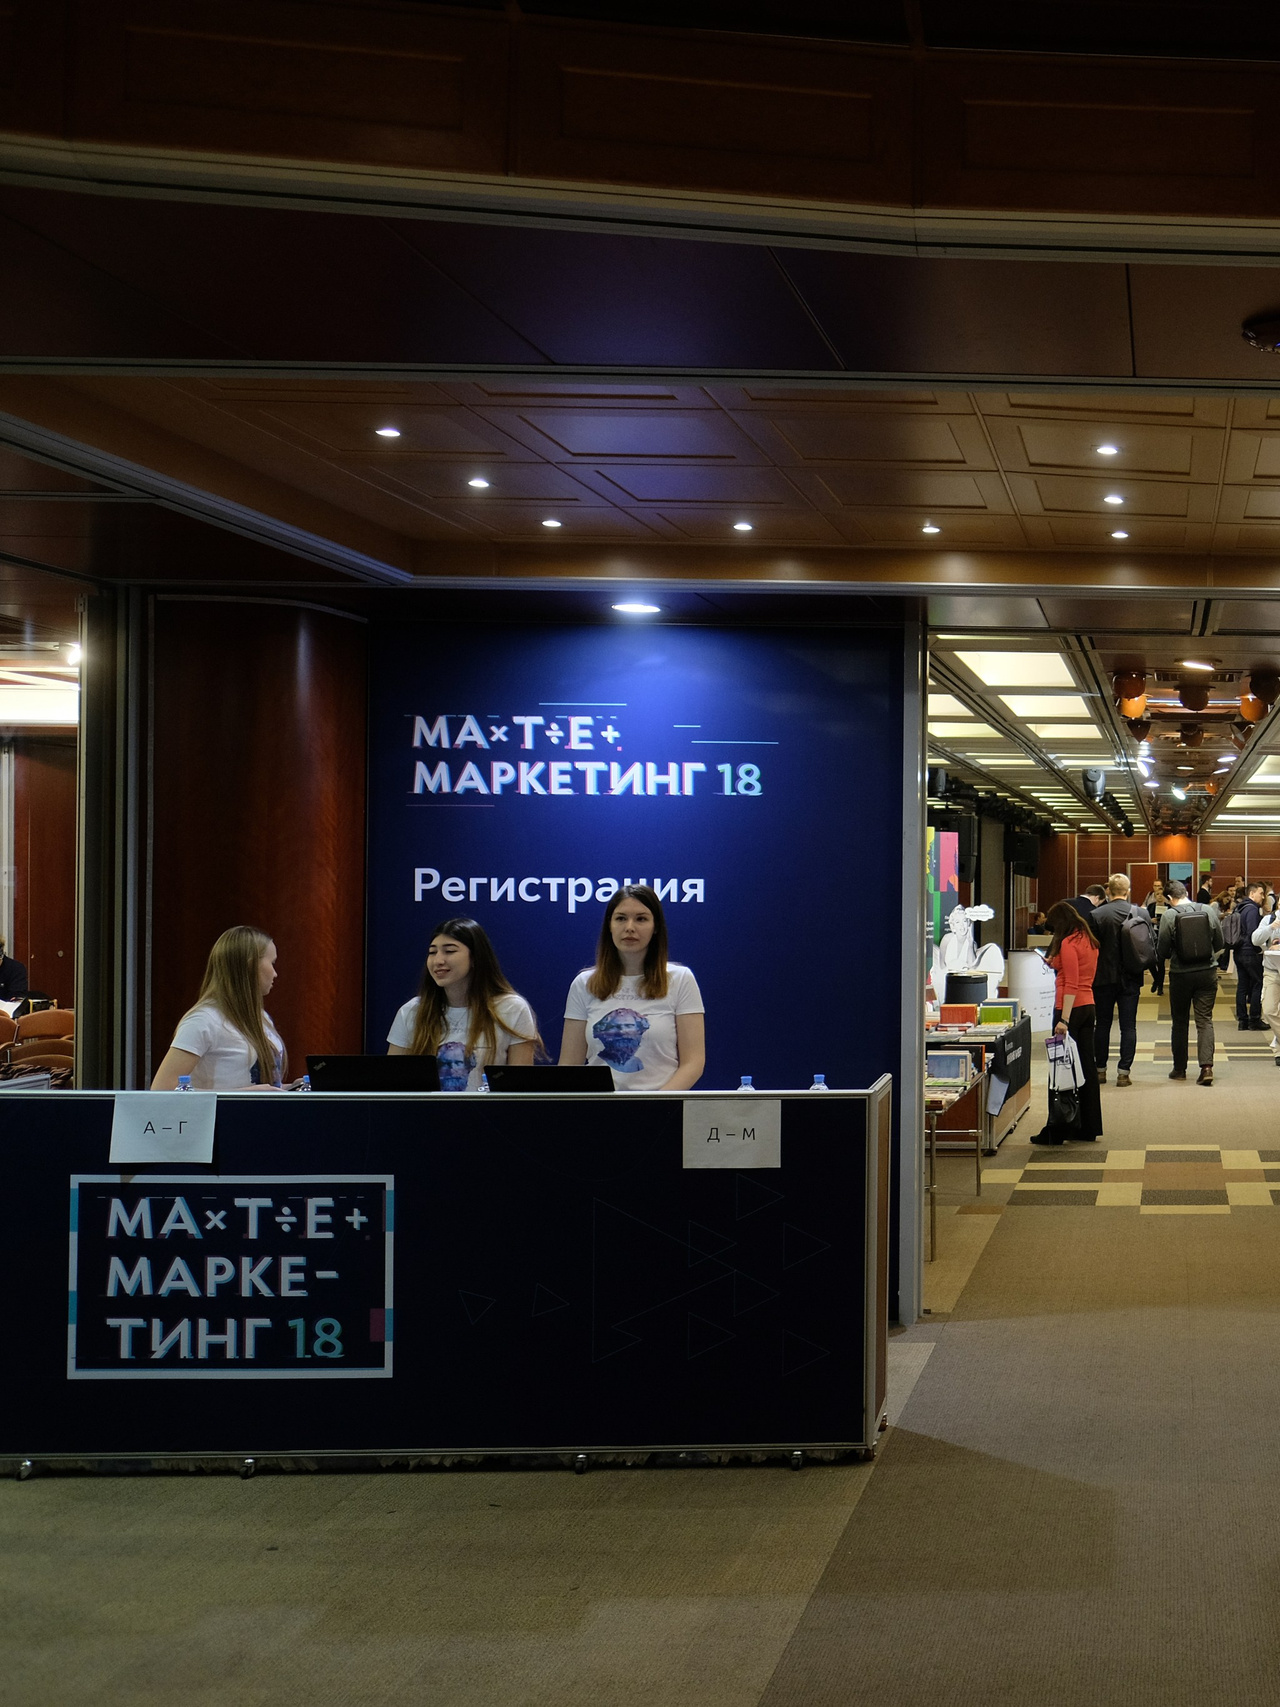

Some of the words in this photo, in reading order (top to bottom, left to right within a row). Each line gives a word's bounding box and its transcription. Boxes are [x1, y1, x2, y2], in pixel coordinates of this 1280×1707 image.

[413, 761, 706, 795] МАРКЕТИНГ
[717, 763, 763, 796] 18
[414, 867, 705, 914] Регистраия
[143, 1121, 155, 1134] А
[179, 1121, 188, 1134] Г
[707, 1127, 720, 1143] Д
[742, 1127, 756, 1141] М
[106, 1317, 272, 1359] ТИНГ
[288, 1317, 345, 1358] 18
